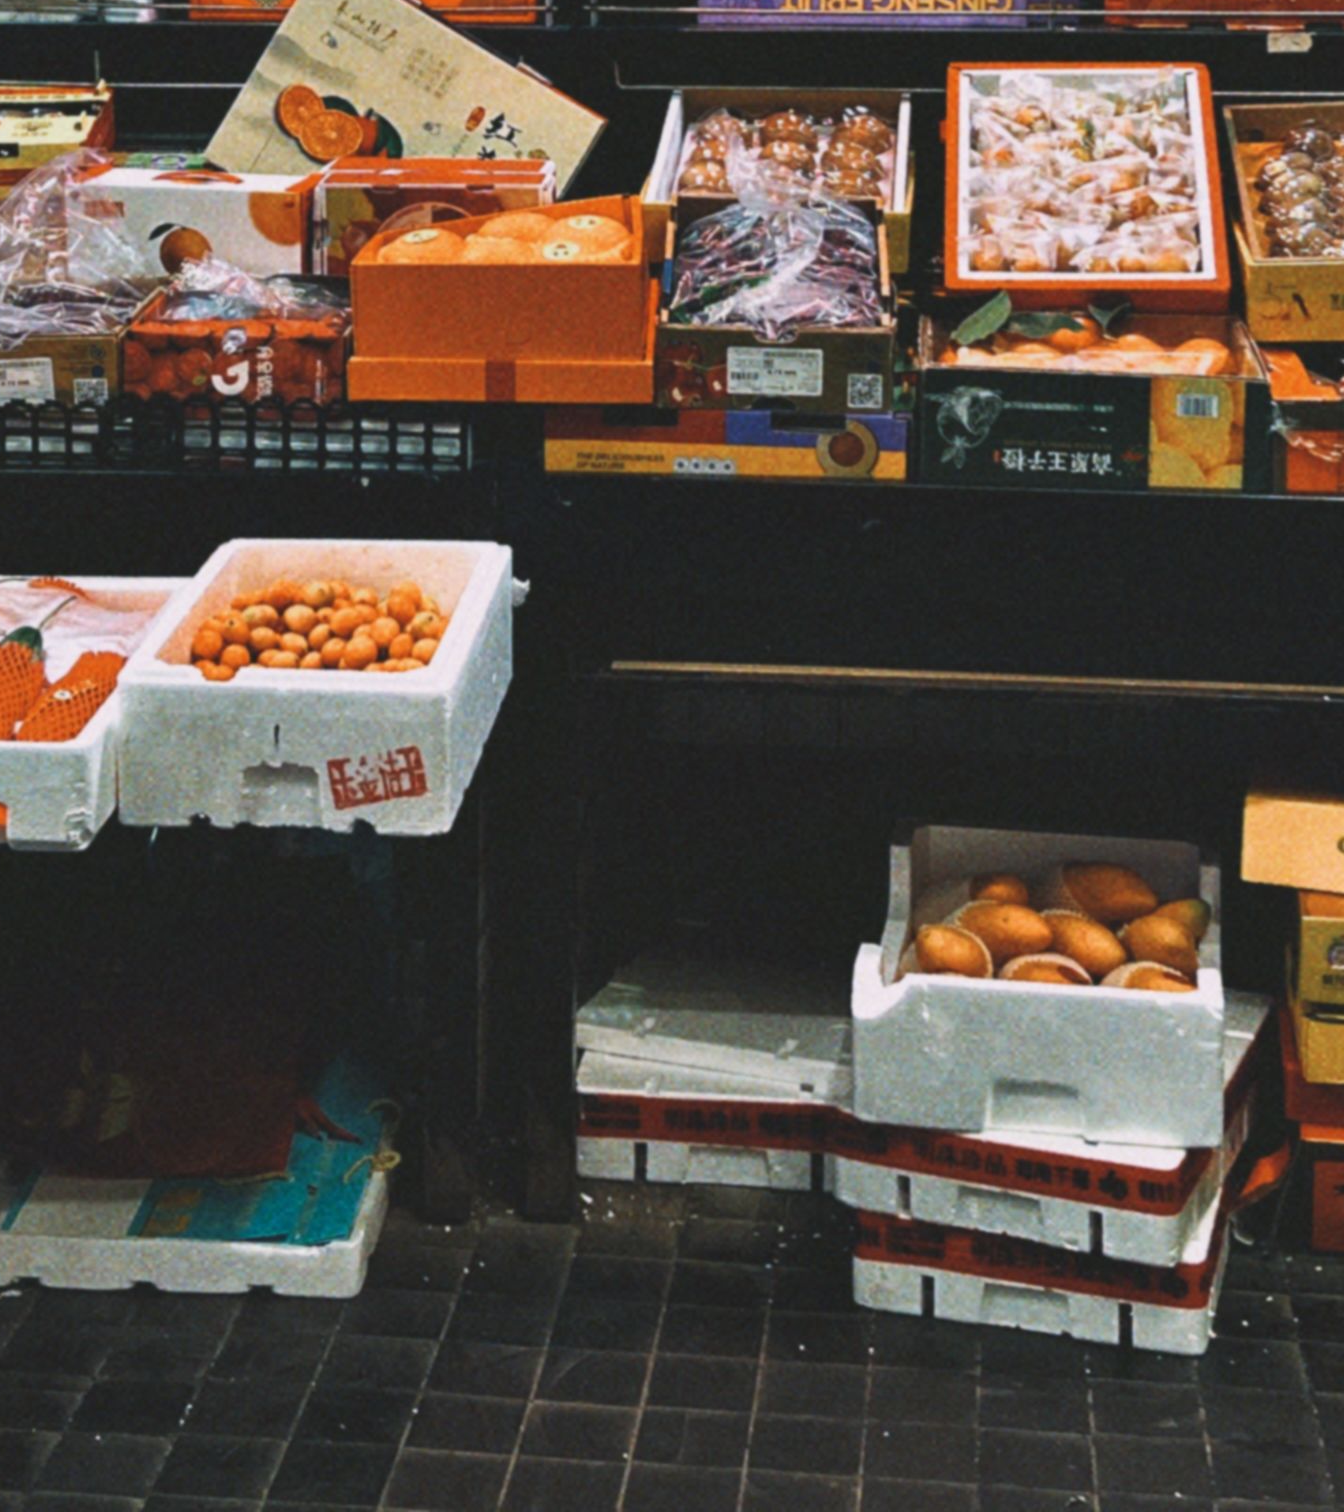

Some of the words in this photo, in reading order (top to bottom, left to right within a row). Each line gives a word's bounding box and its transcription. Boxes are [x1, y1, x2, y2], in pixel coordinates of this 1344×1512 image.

[1000, 448, 1114, 477] 高原王子橙
